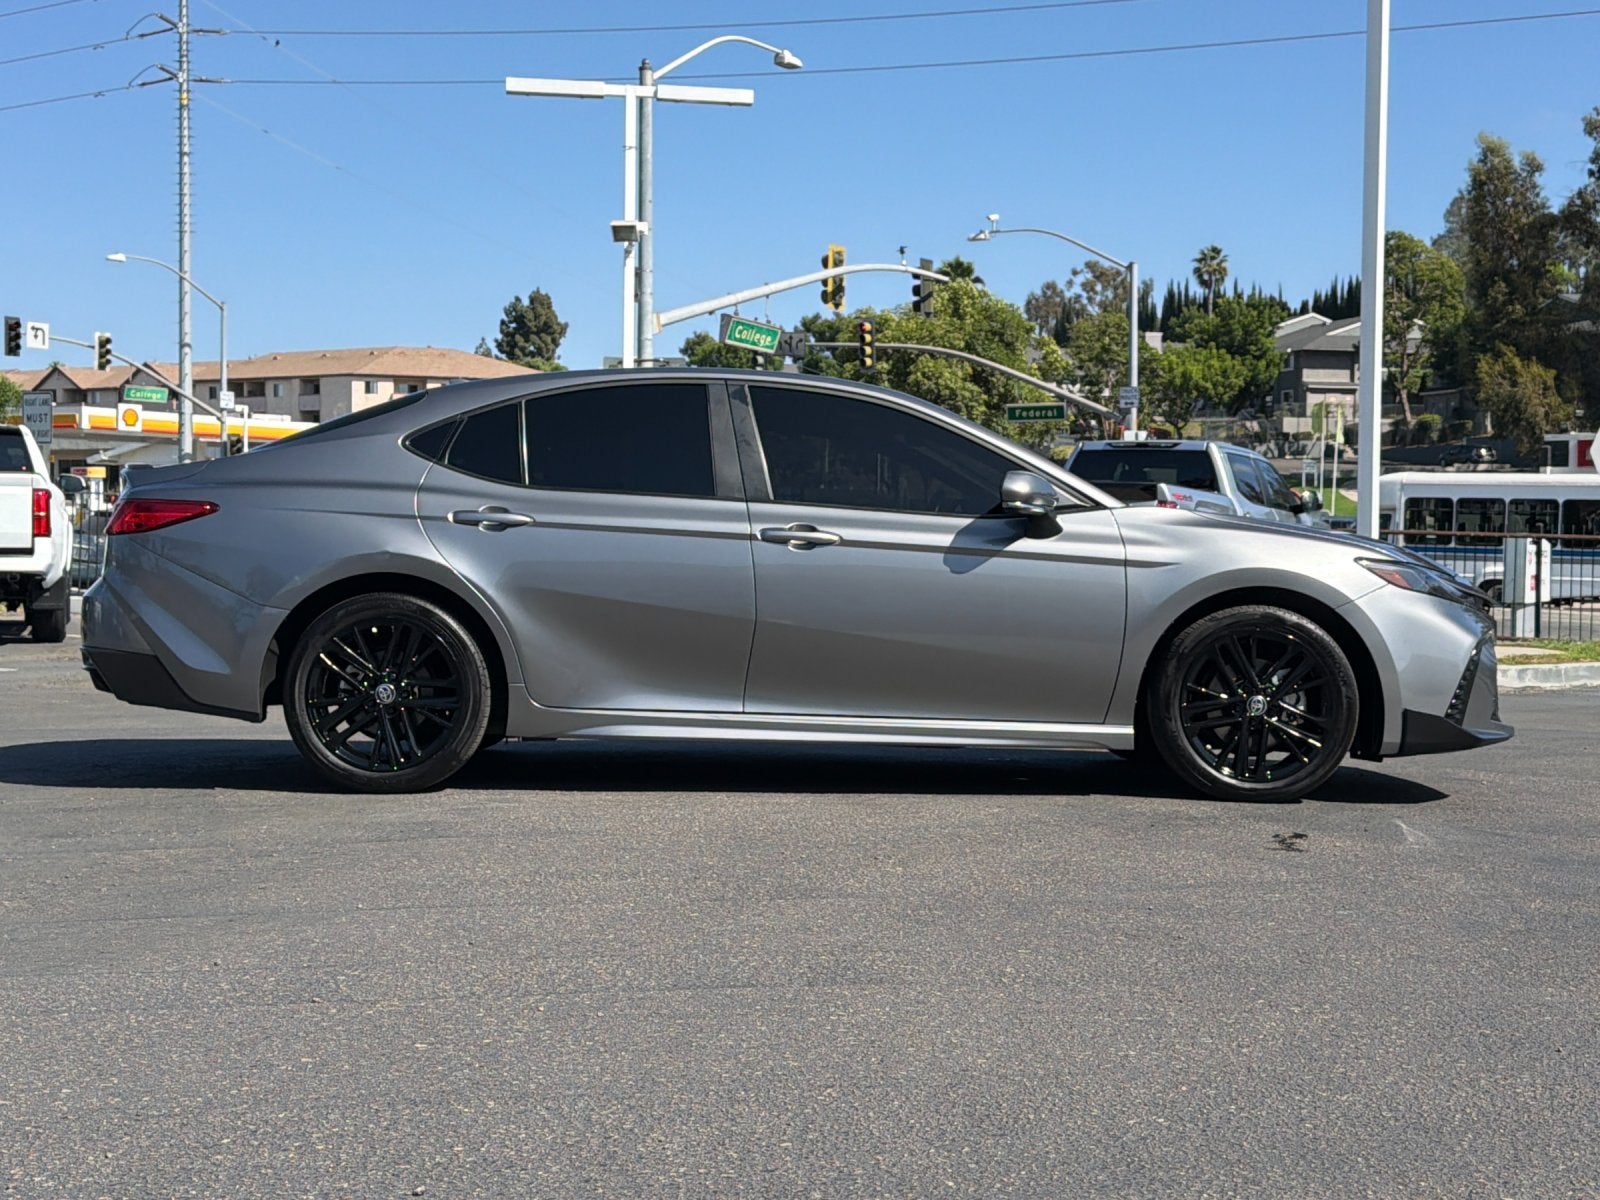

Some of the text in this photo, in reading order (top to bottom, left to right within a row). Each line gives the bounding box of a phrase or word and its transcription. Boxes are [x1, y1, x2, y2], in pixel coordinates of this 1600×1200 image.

[735, 325, 772, 347] College
[26, 413, 48, 423] MUST
[1015, 408, 1057, 418] Federal
